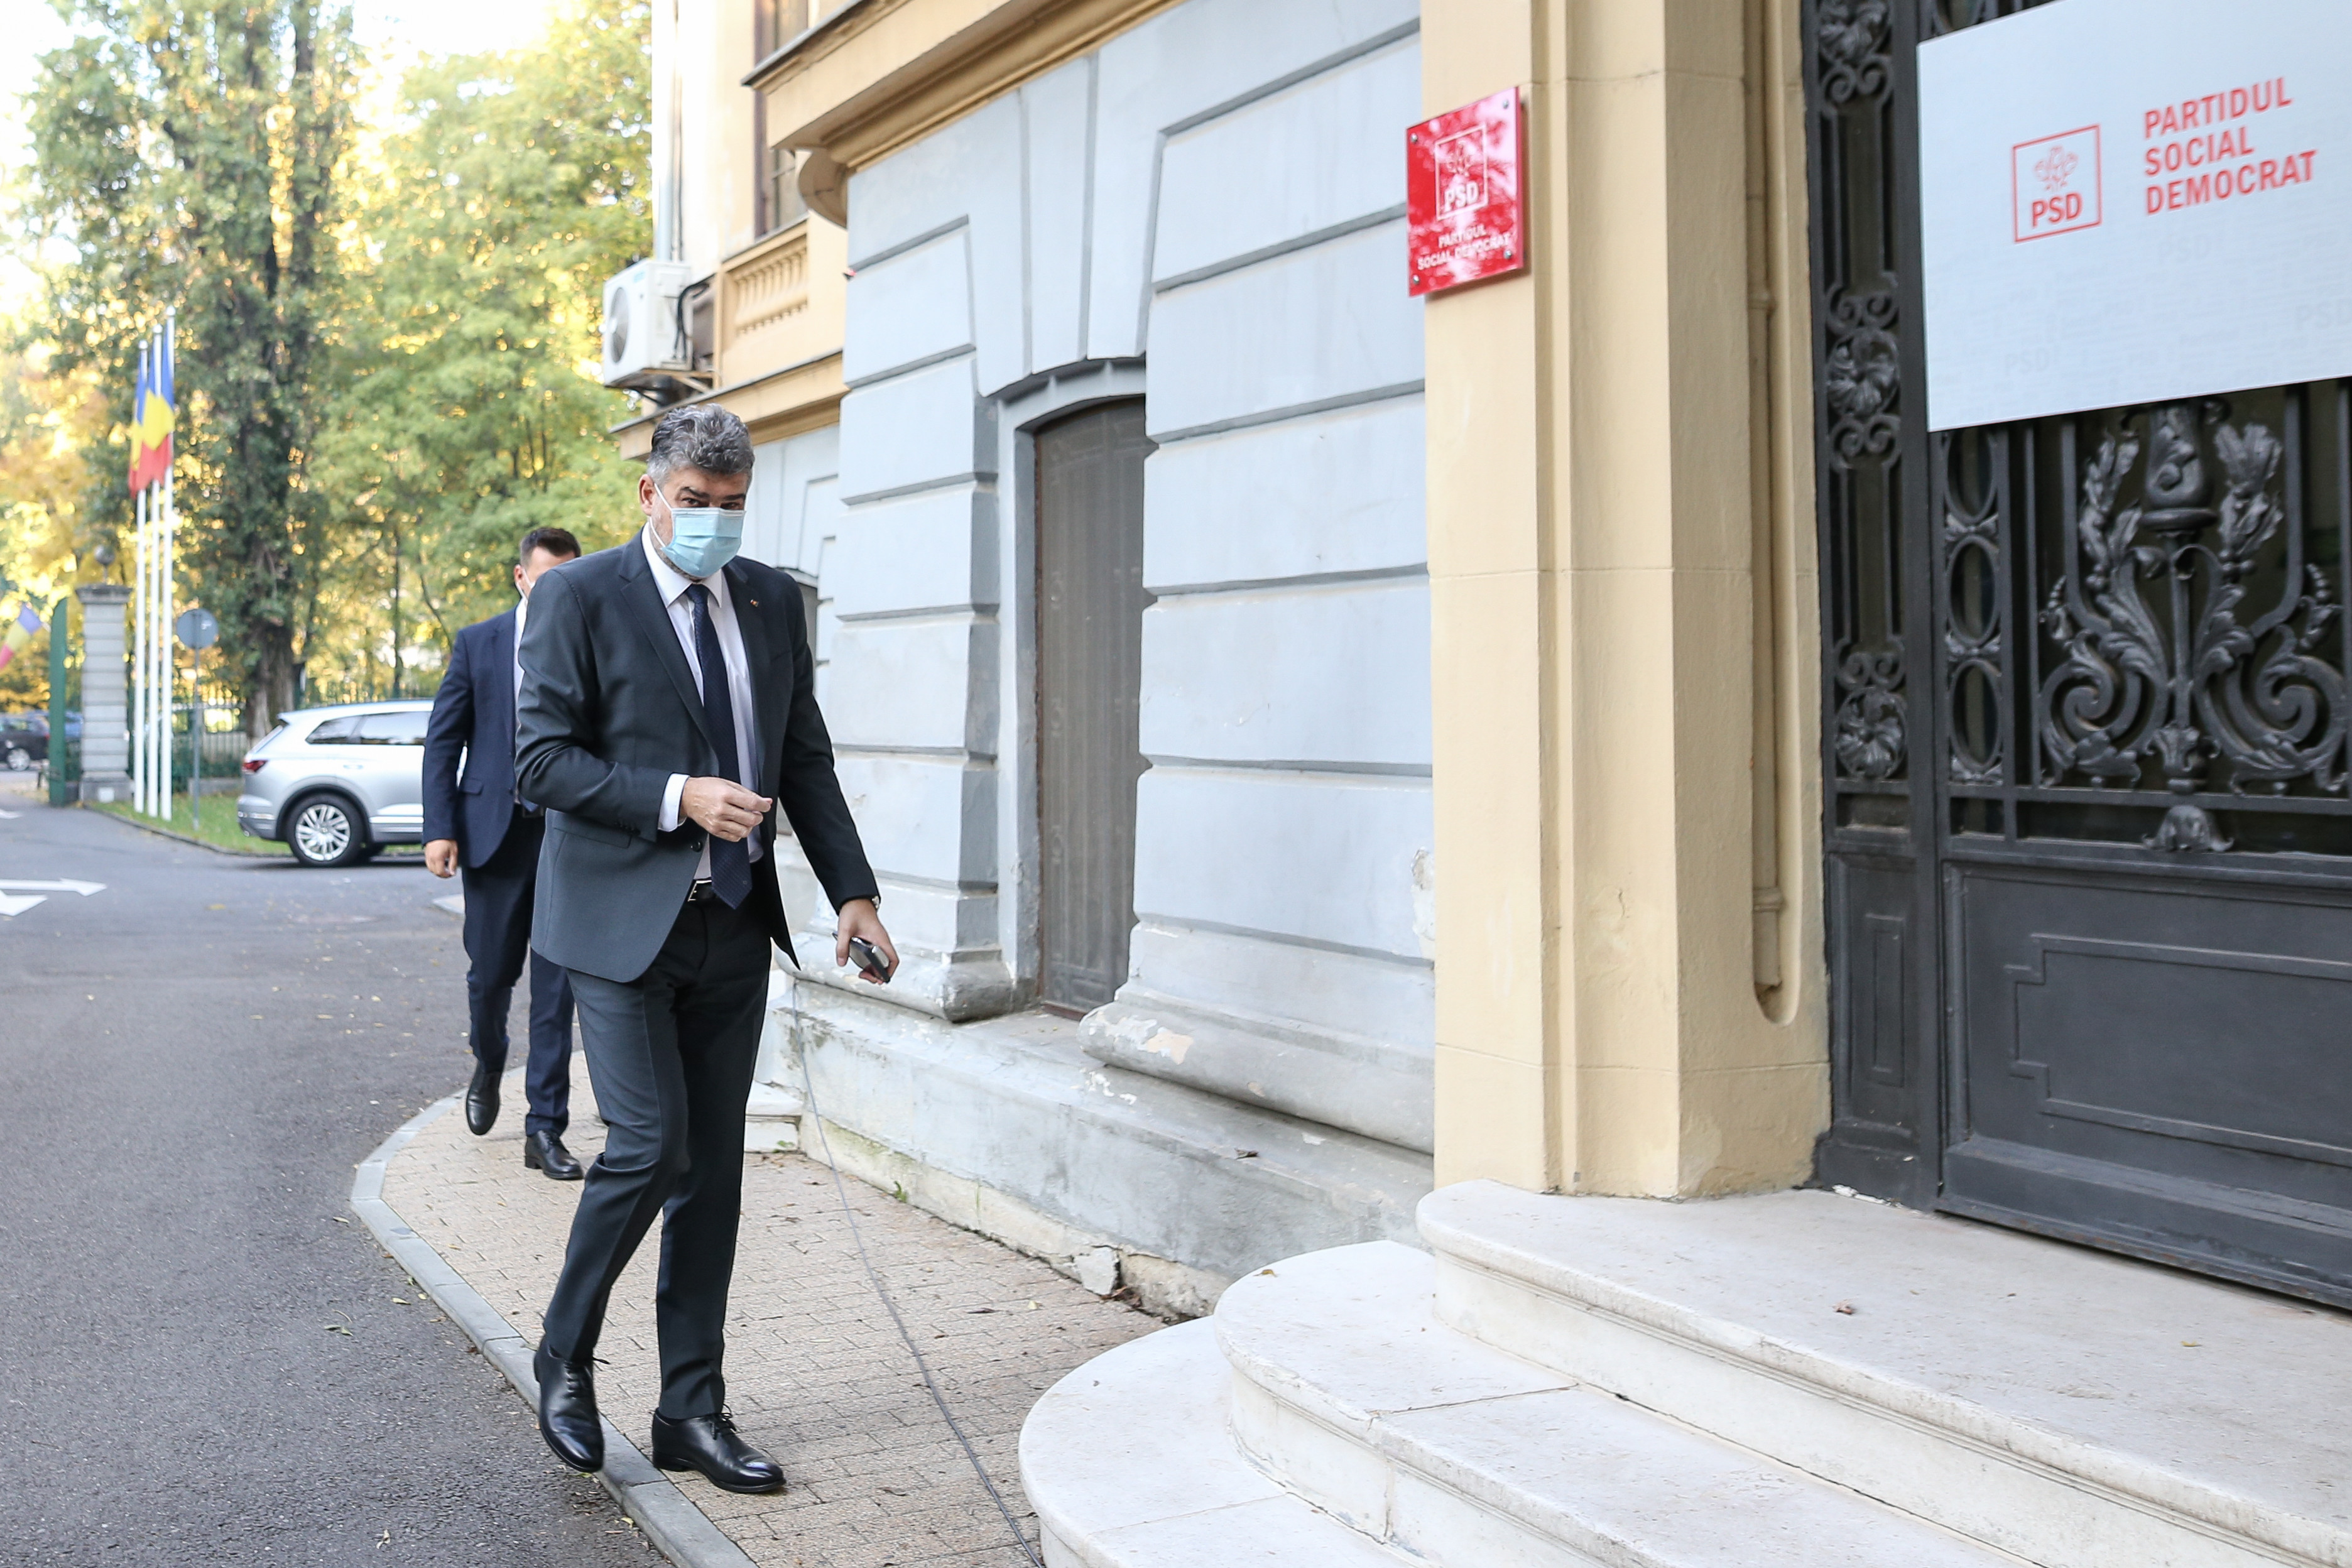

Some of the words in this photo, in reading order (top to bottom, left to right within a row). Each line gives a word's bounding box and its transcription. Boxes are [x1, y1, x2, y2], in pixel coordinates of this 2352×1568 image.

[2144, 77, 2294, 139] PARTIDUL
[2144, 125, 2255, 177] SOCIAL
[1445, 182, 1479, 212] PSD
[2146, 148, 2318, 215] DEMOCRAT
[2031, 192, 2083, 229] PSD
[1417, 250, 1453, 270] SOCIAL
